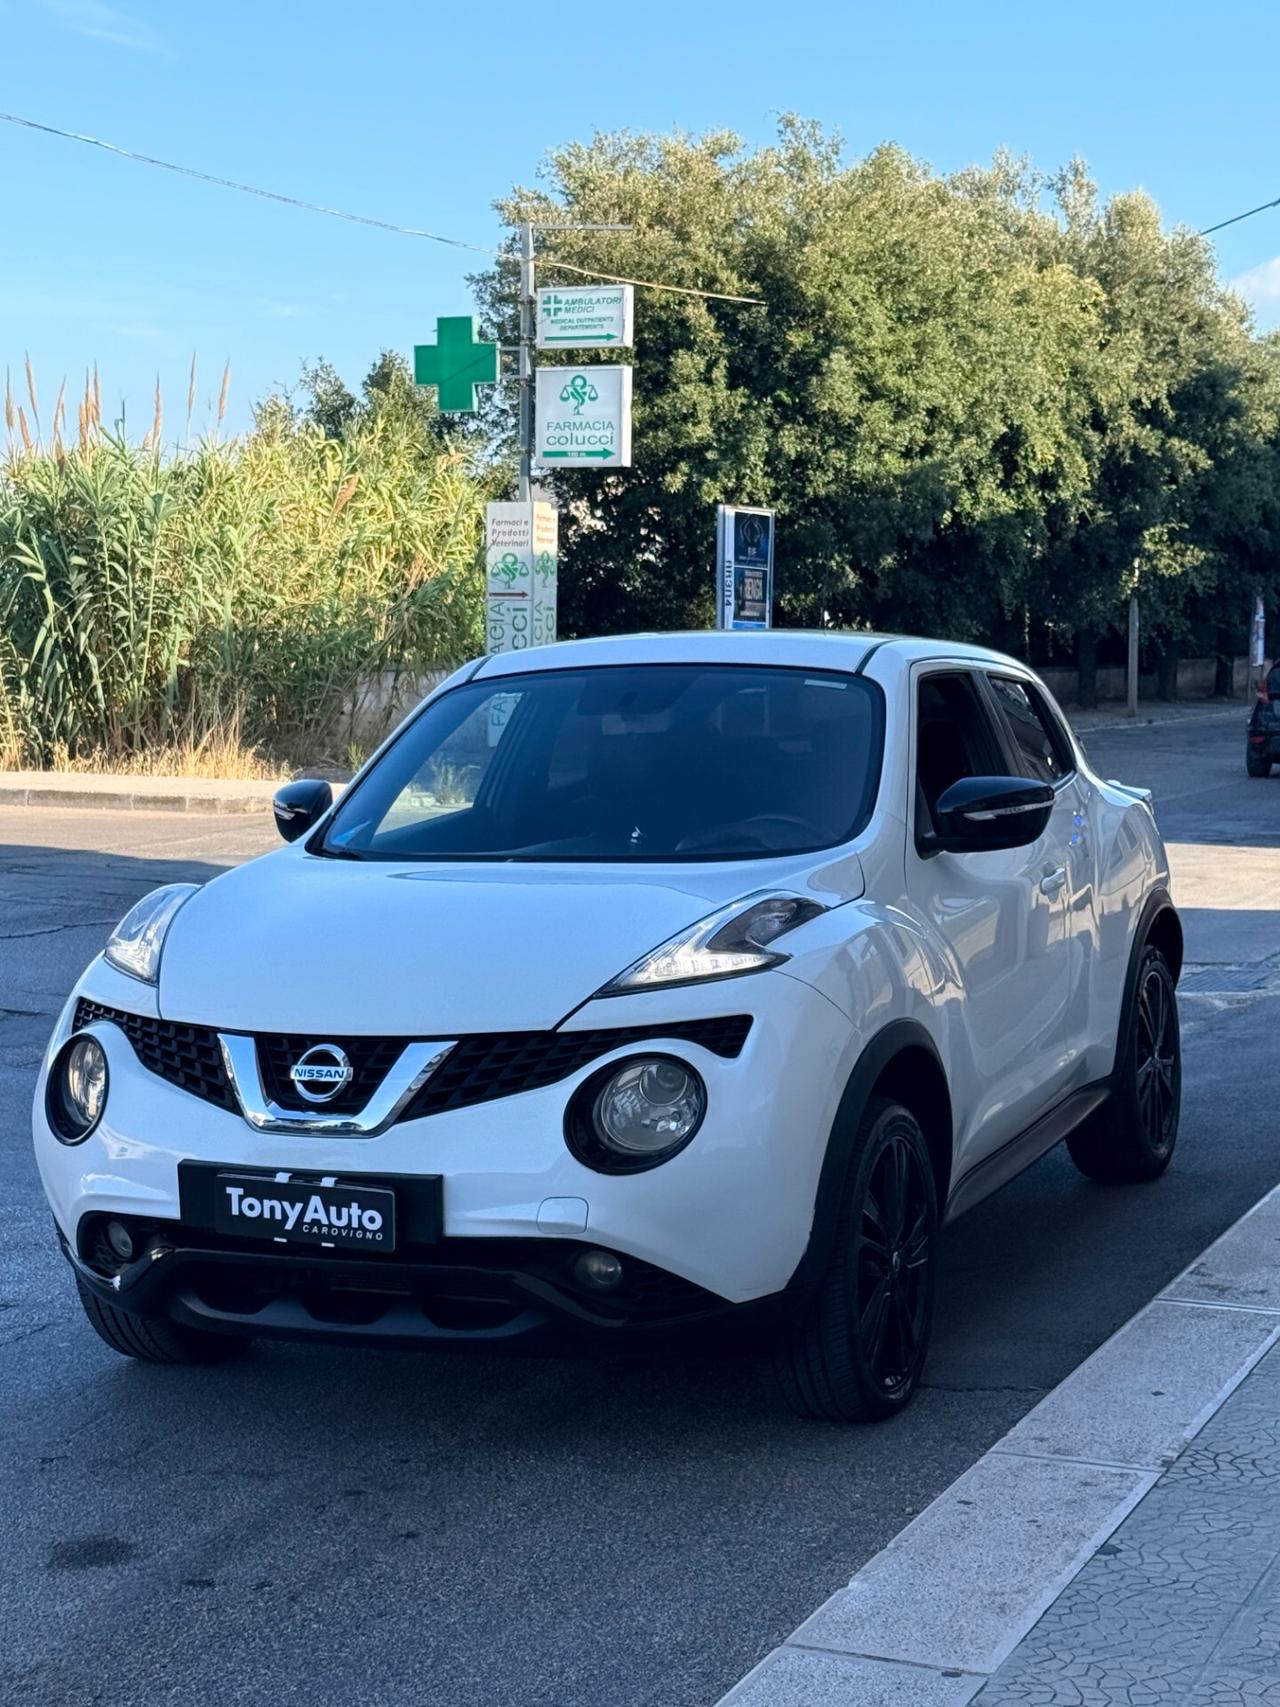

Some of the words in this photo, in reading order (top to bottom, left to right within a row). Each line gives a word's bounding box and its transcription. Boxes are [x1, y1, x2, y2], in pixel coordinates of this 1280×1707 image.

[564, 296, 622, 306] AMBULATORI
[564, 306, 595, 314] MEDICI
[546, 421, 614, 432] FARMACIA
[545, 432, 614, 446] colucci
[491, 528, 529, 537] Prodotti
[491, 539, 529, 547] Veterinari
[489, 601, 505, 654] ACIA
[506, 607, 528, 650] cci
[294, 1067, 345, 1079] NISSAN
[225, 1186, 383, 1231] TonyAuto
[302, 1224, 384, 1241] CAROVIGNO
